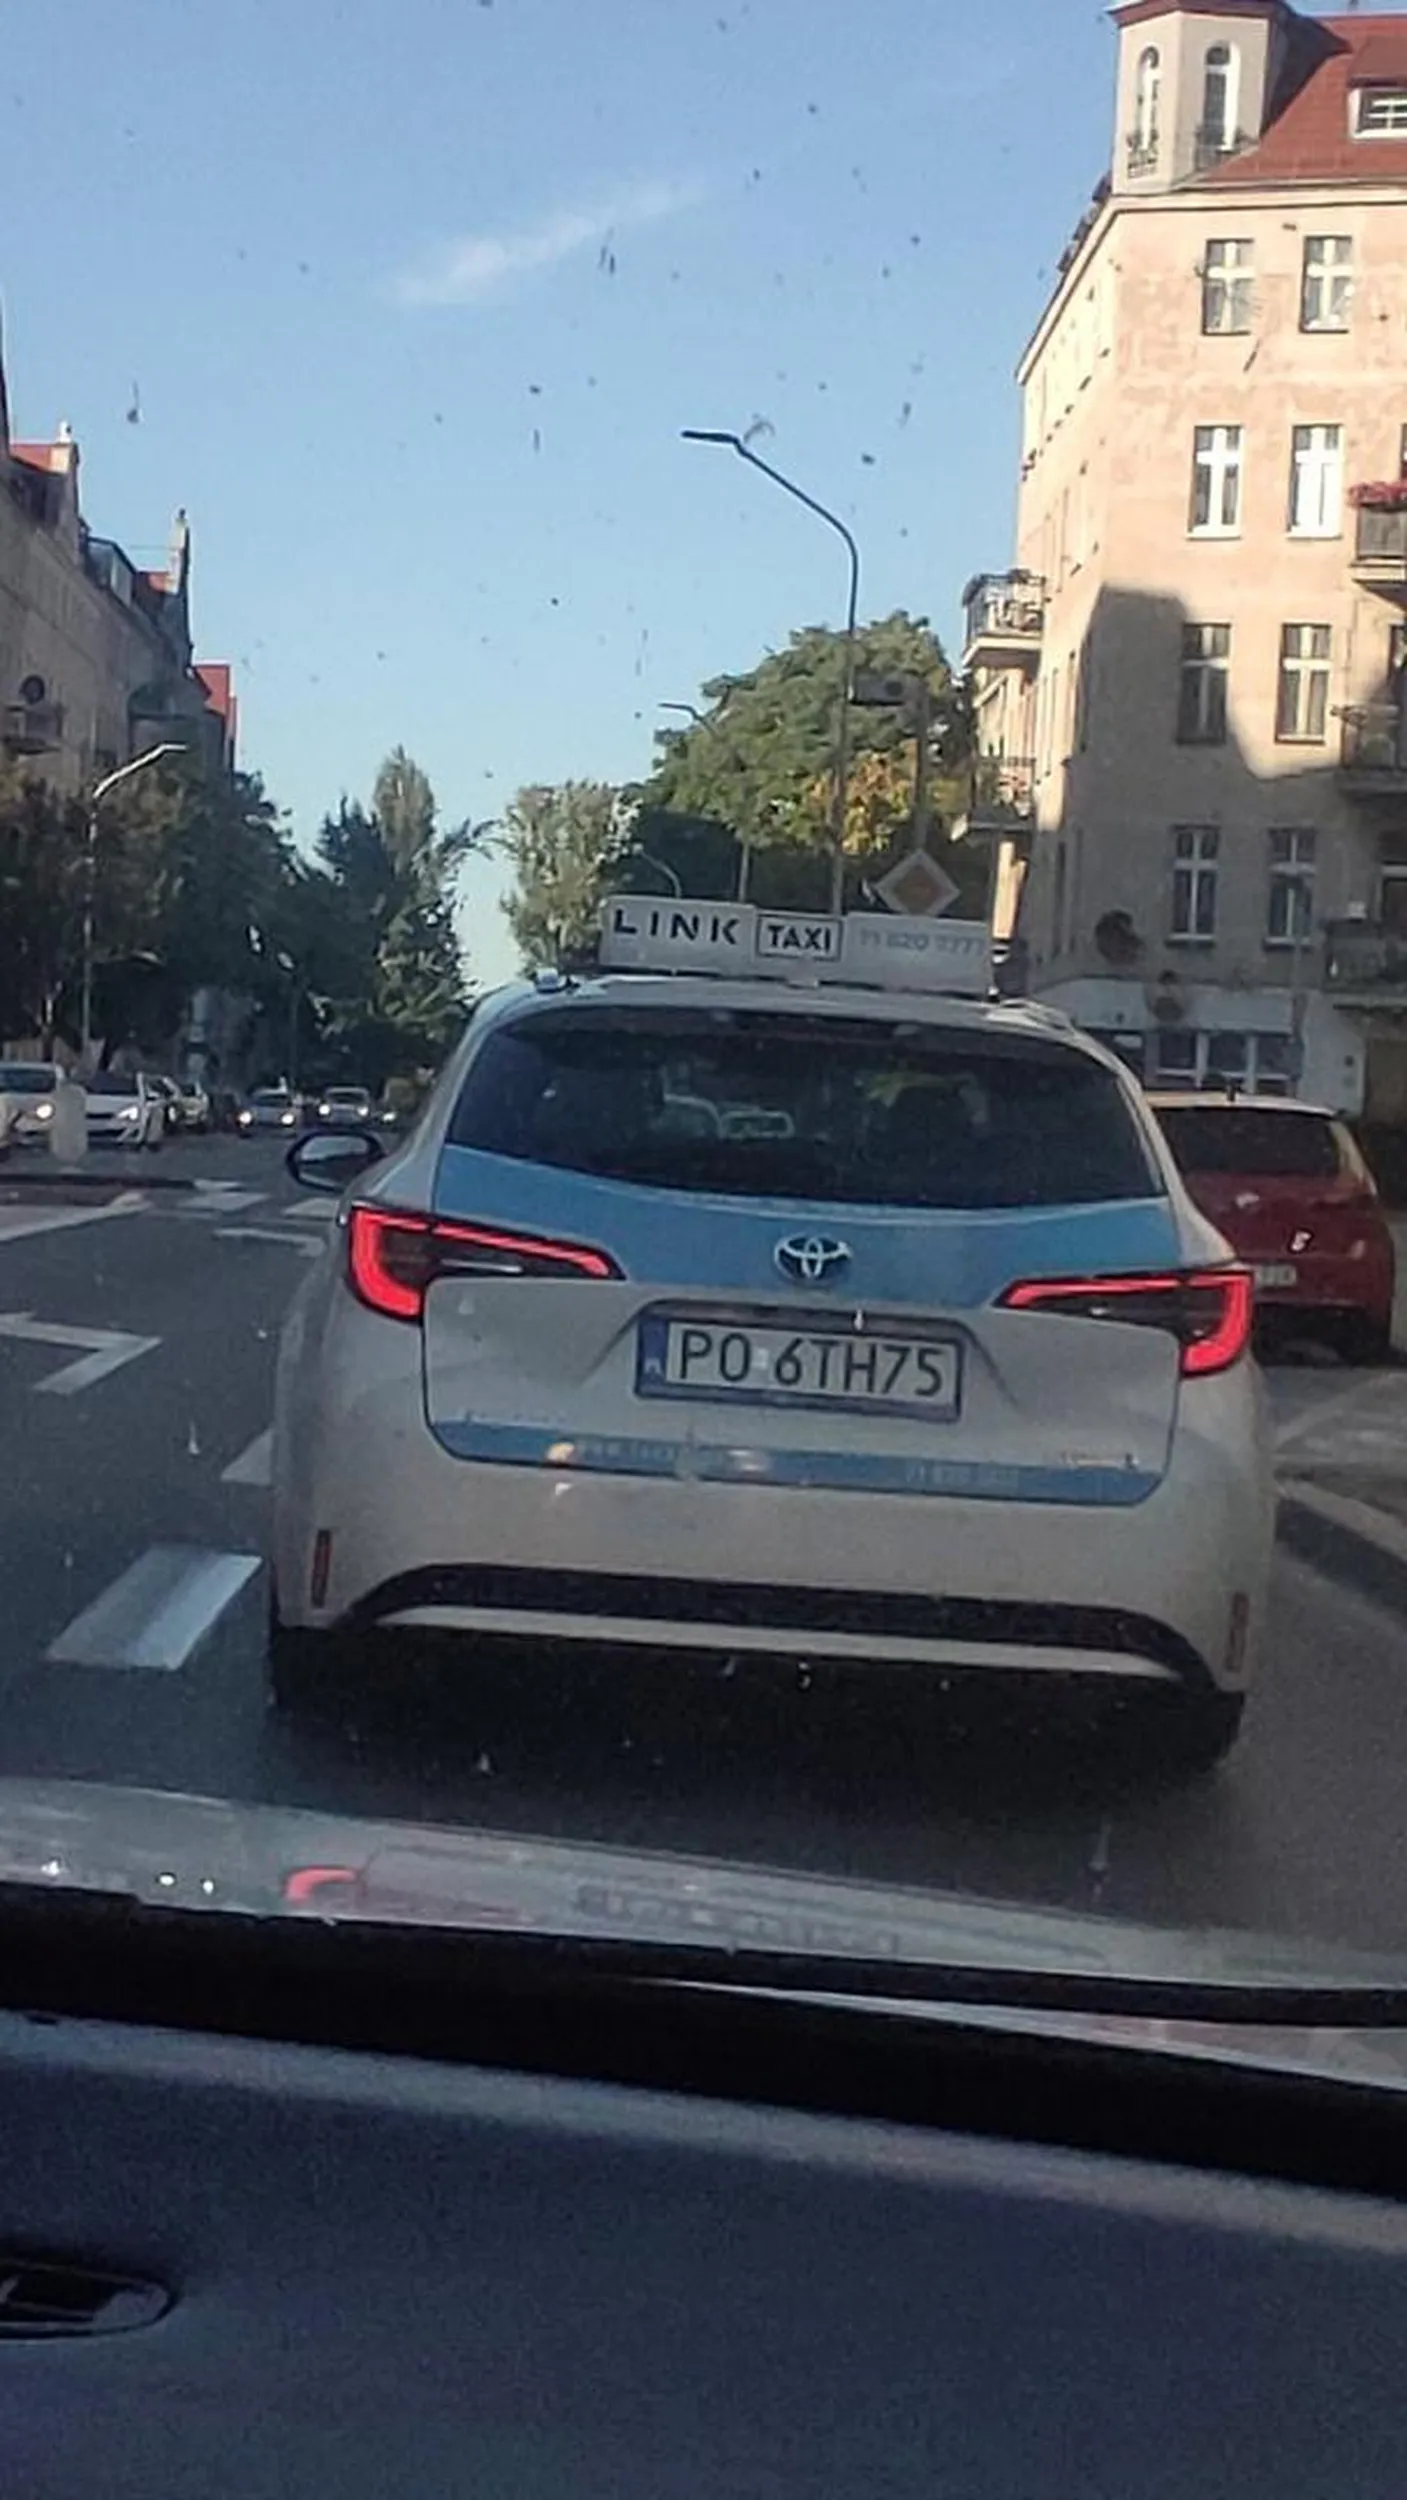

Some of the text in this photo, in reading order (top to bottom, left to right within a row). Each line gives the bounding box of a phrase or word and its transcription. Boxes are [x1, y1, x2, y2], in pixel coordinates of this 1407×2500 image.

[613, 908, 741, 945] LINK
[767, 924, 832, 953] TAXI
[679, 1329, 944, 1397] PO 6TH75
